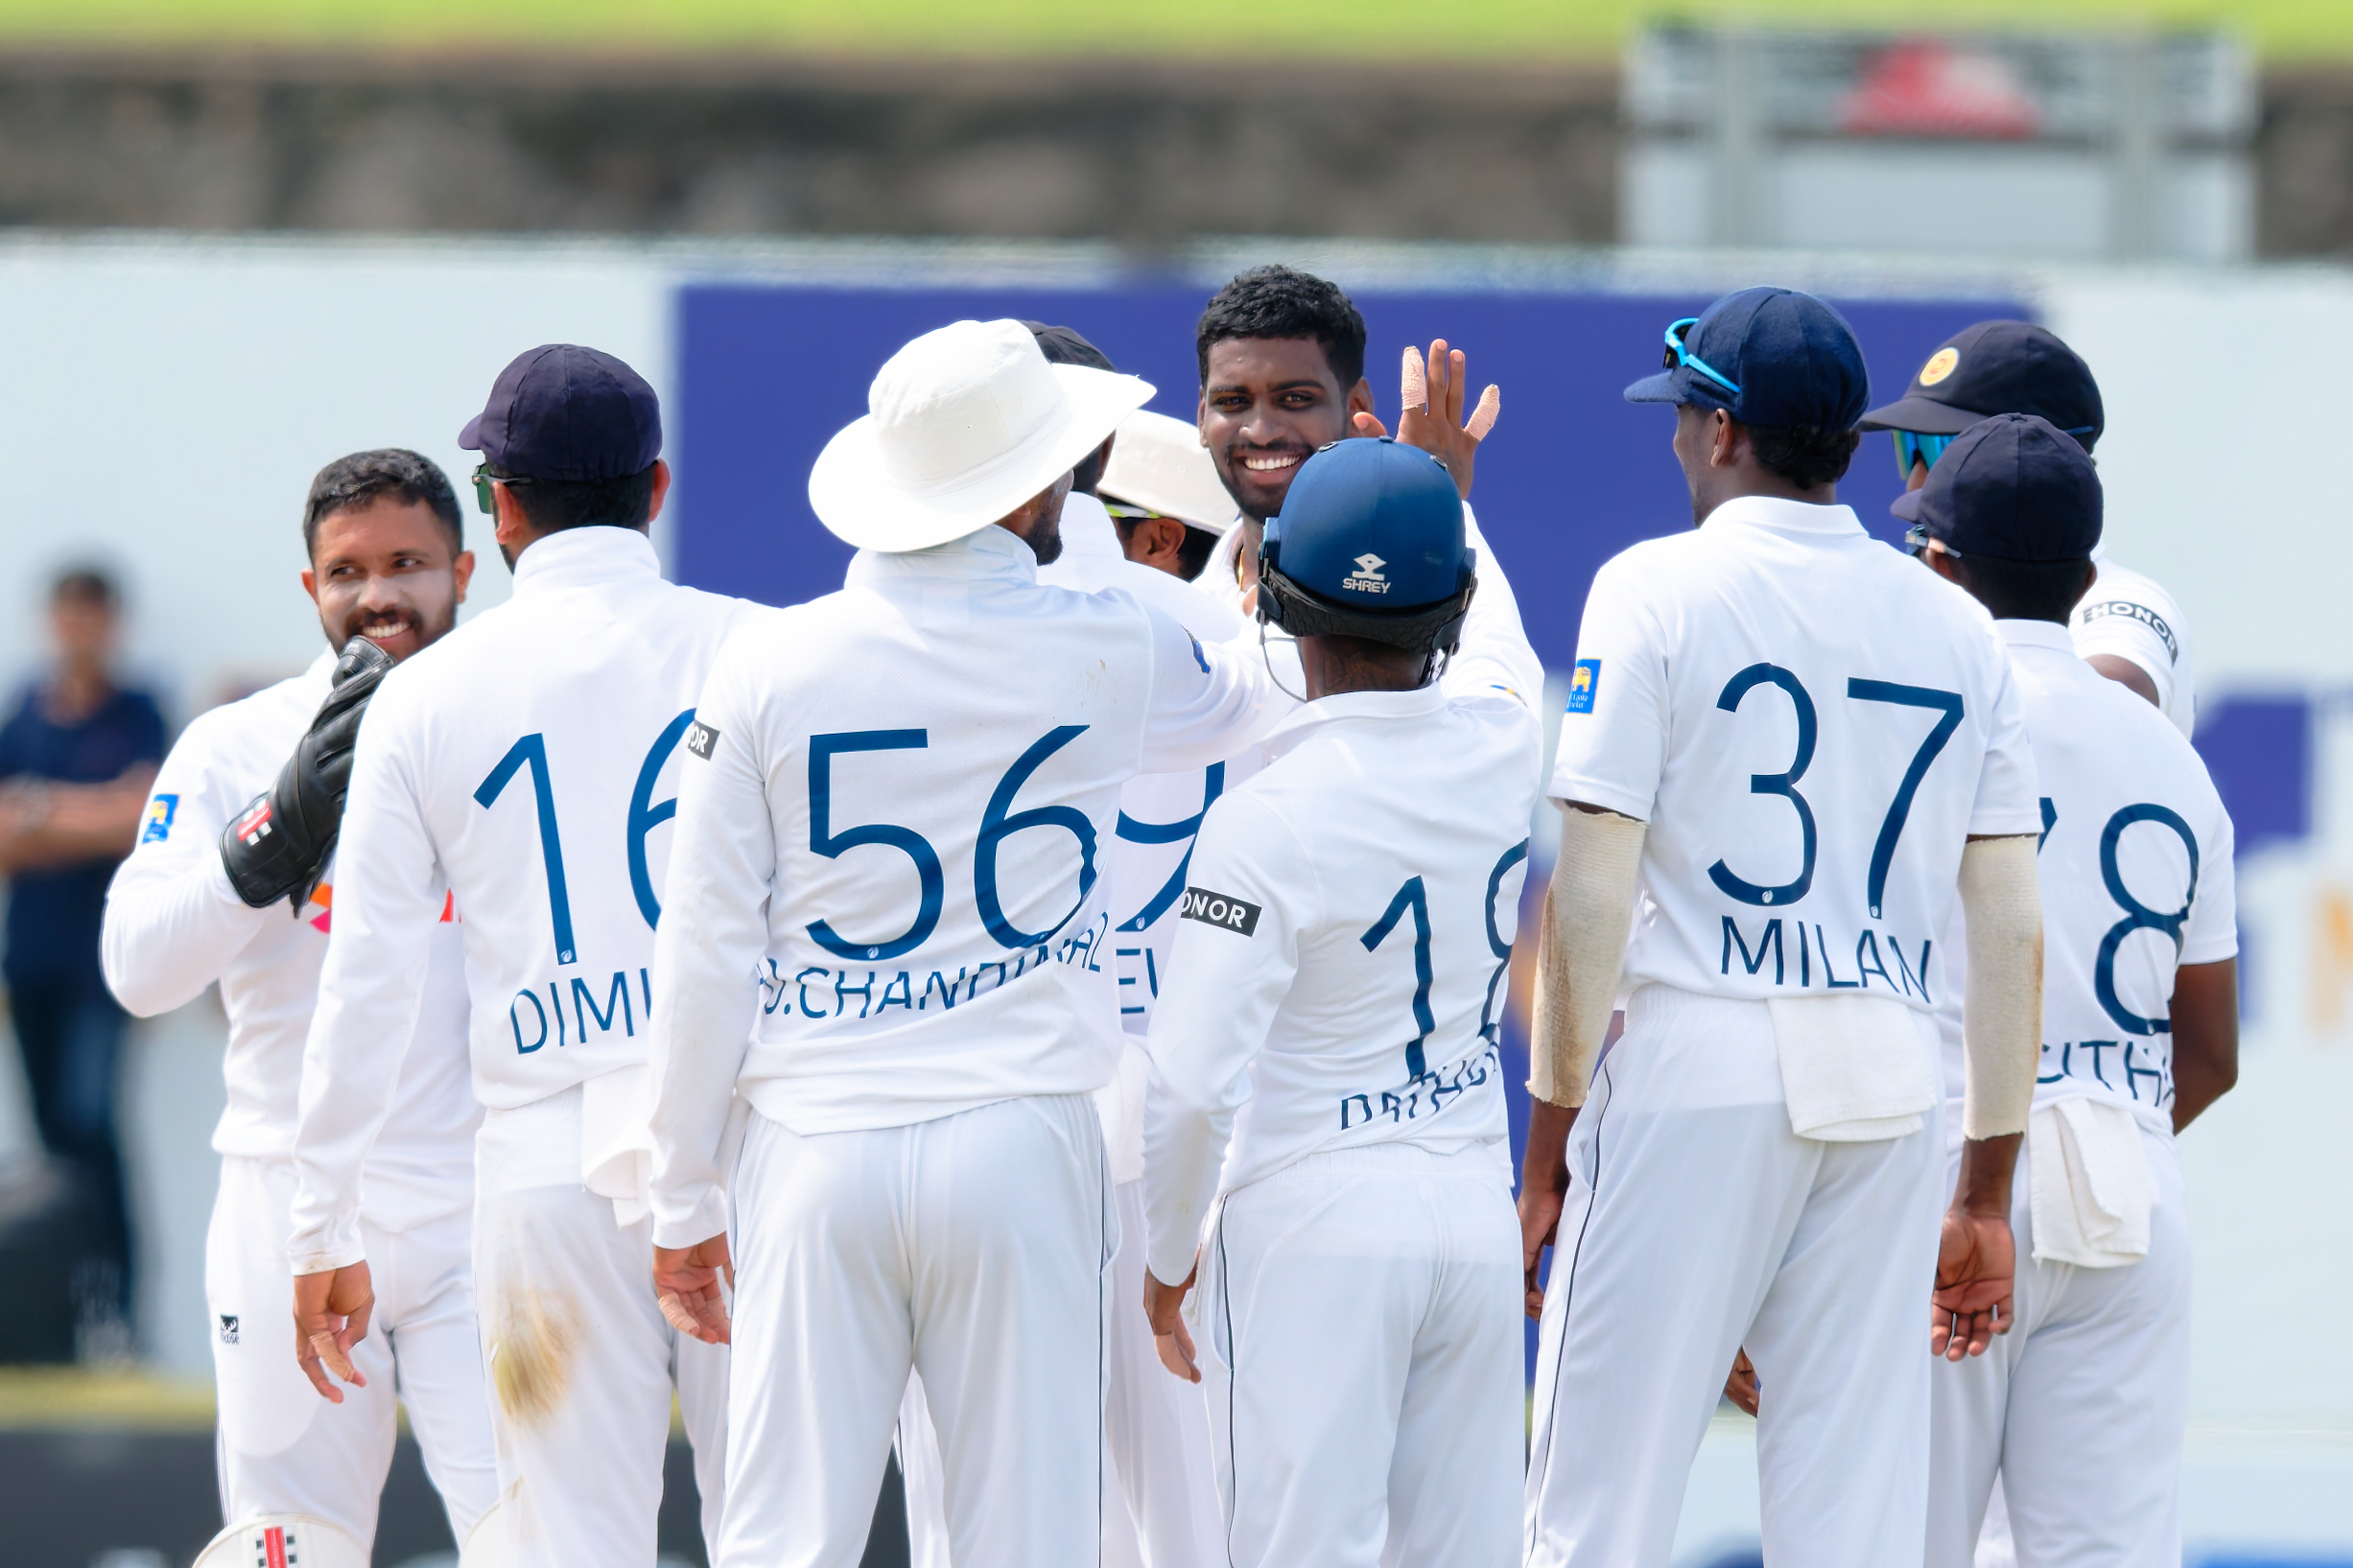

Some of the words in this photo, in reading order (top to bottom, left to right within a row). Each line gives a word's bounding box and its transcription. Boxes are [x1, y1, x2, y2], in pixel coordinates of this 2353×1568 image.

[1342, 577, 1391, 595] SHREY
[473, 707, 696, 966] 16
[805, 724, 1097, 962] 56
[1707, 662, 1965, 920] 37
[1721, 916, 1933, 1005] MILAN
